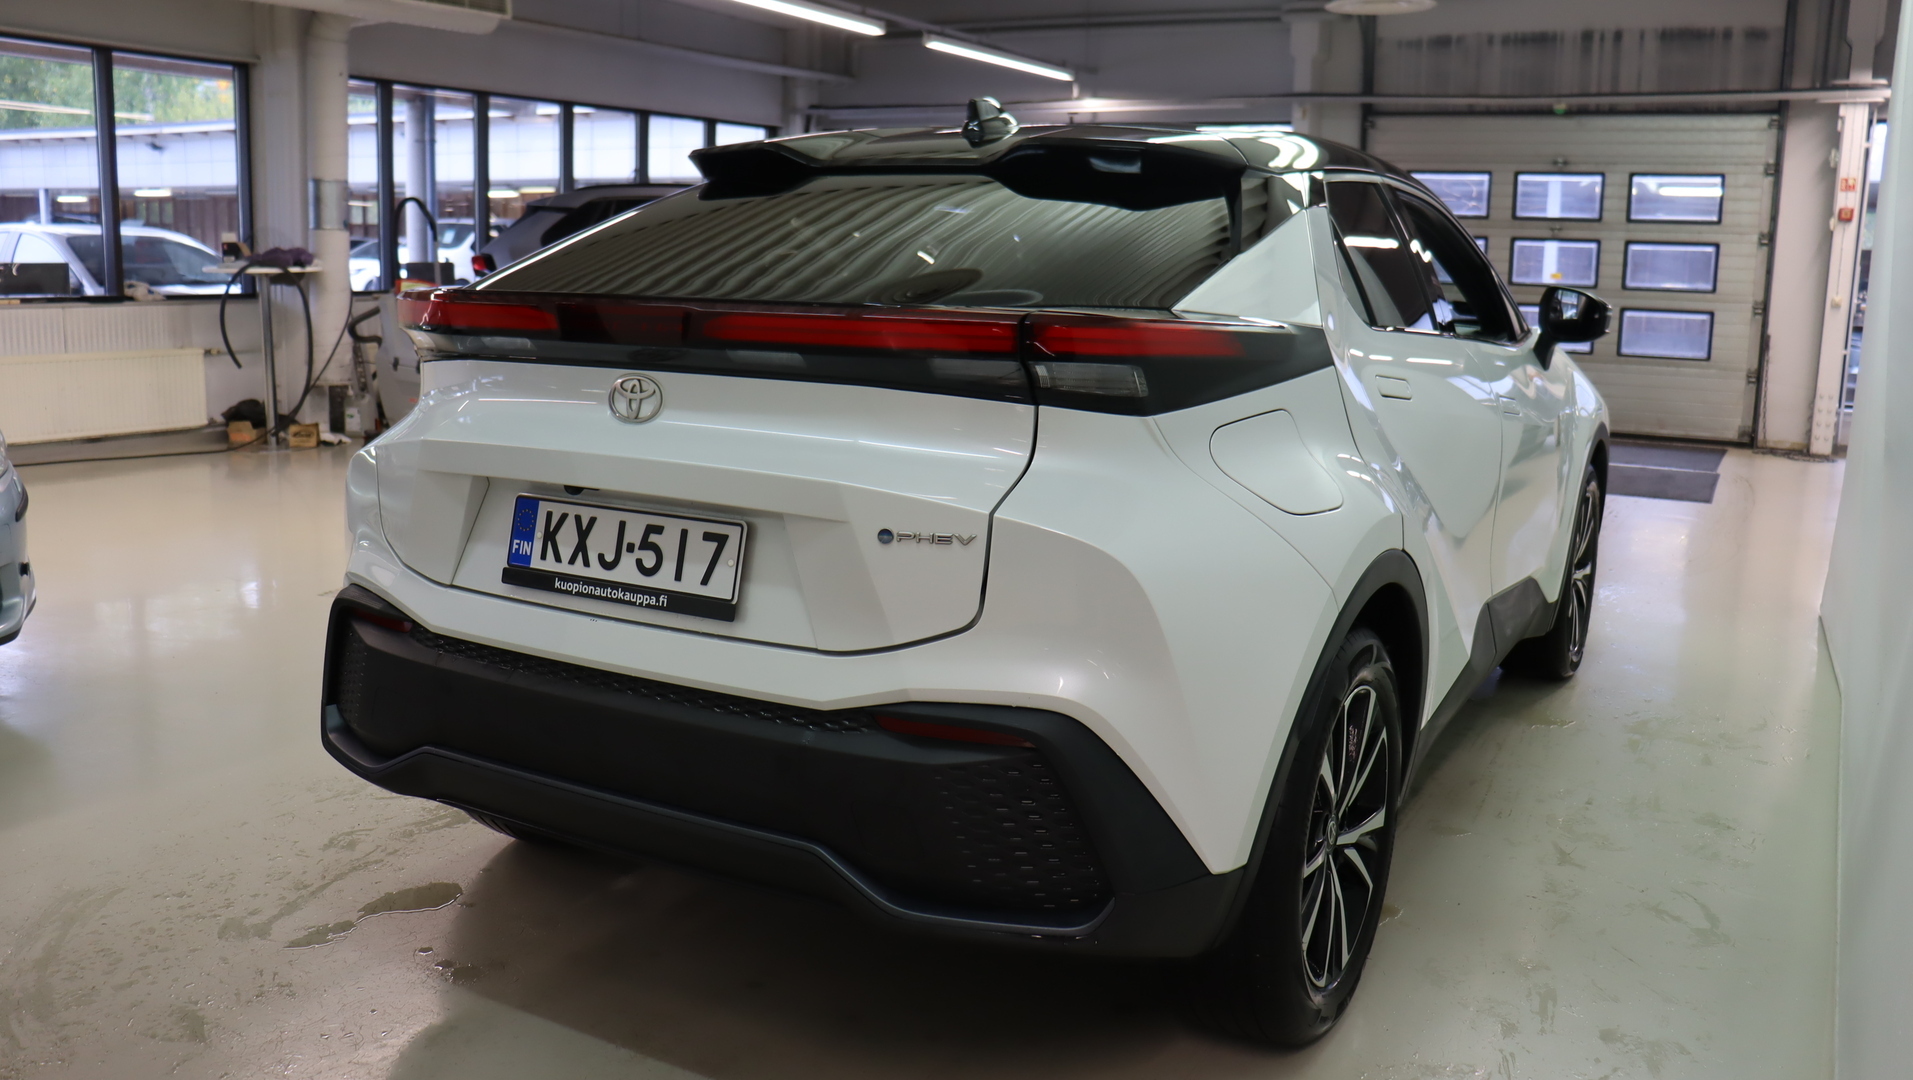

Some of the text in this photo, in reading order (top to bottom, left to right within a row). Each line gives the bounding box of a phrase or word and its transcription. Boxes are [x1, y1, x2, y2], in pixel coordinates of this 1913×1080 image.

[896, 531, 978, 546] PHEV
[512, 539, 532, 556] FIN
[554, 577, 668, 608] kuopionautokauppa.fi
